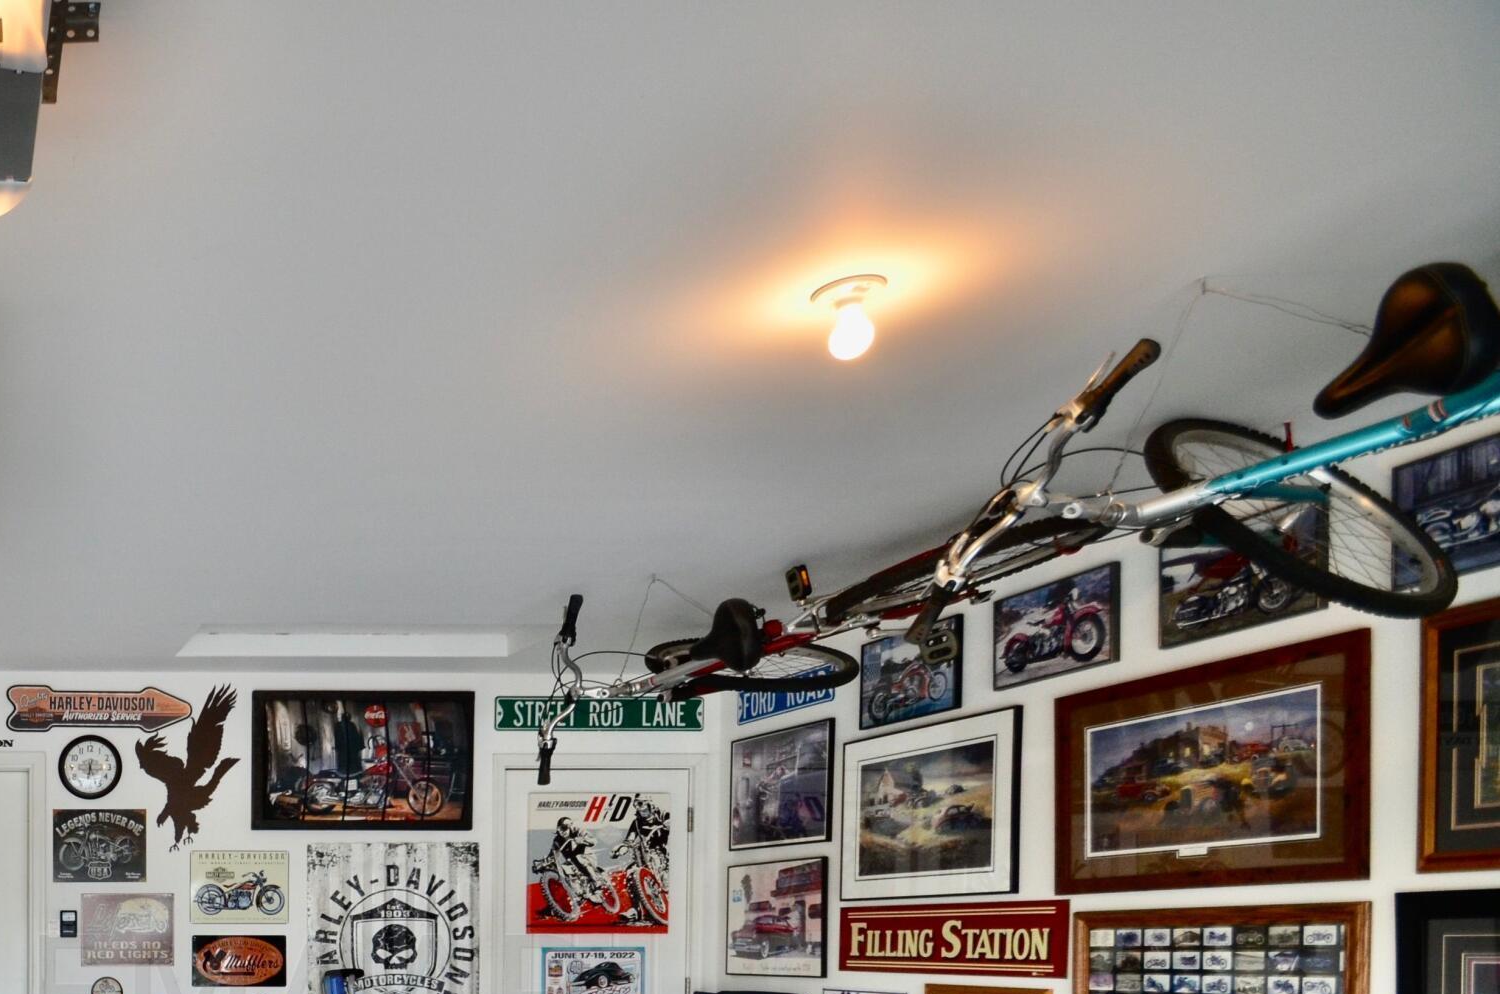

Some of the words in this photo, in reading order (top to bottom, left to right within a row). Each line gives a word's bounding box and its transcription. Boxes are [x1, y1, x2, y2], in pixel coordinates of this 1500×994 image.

[49, 696, 156, 712] HARLEY-DAVIDSON
[742, 690, 776, 720] FORD
[589, 701, 624, 727] ROD
[642, 700, 687, 727] LANE
[86, 744, 94, 753] 12
[70, 753, 79, 762] 10
[104, 754, 110, 762] 2
[55, 811, 97, 838] LEGENDS
[98, 811, 128, 828] NEVER
[127, 819, 145, 837] DIE
[380, 909, 411, 919] 1903
[315, 864, 476, 986] ARLEY-DAVIDSON
[849, 922, 935, 957] FILLING
[941, 920, 1050, 961] STATION
[86, 950, 115, 959] RED
[119, 950, 169, 960] LIGHTS
[225, 952, 278, 972] Mufflers
[551, 952, 578, 960] JUNE
[354, 974, 439, 990] MOTORCYCLES
